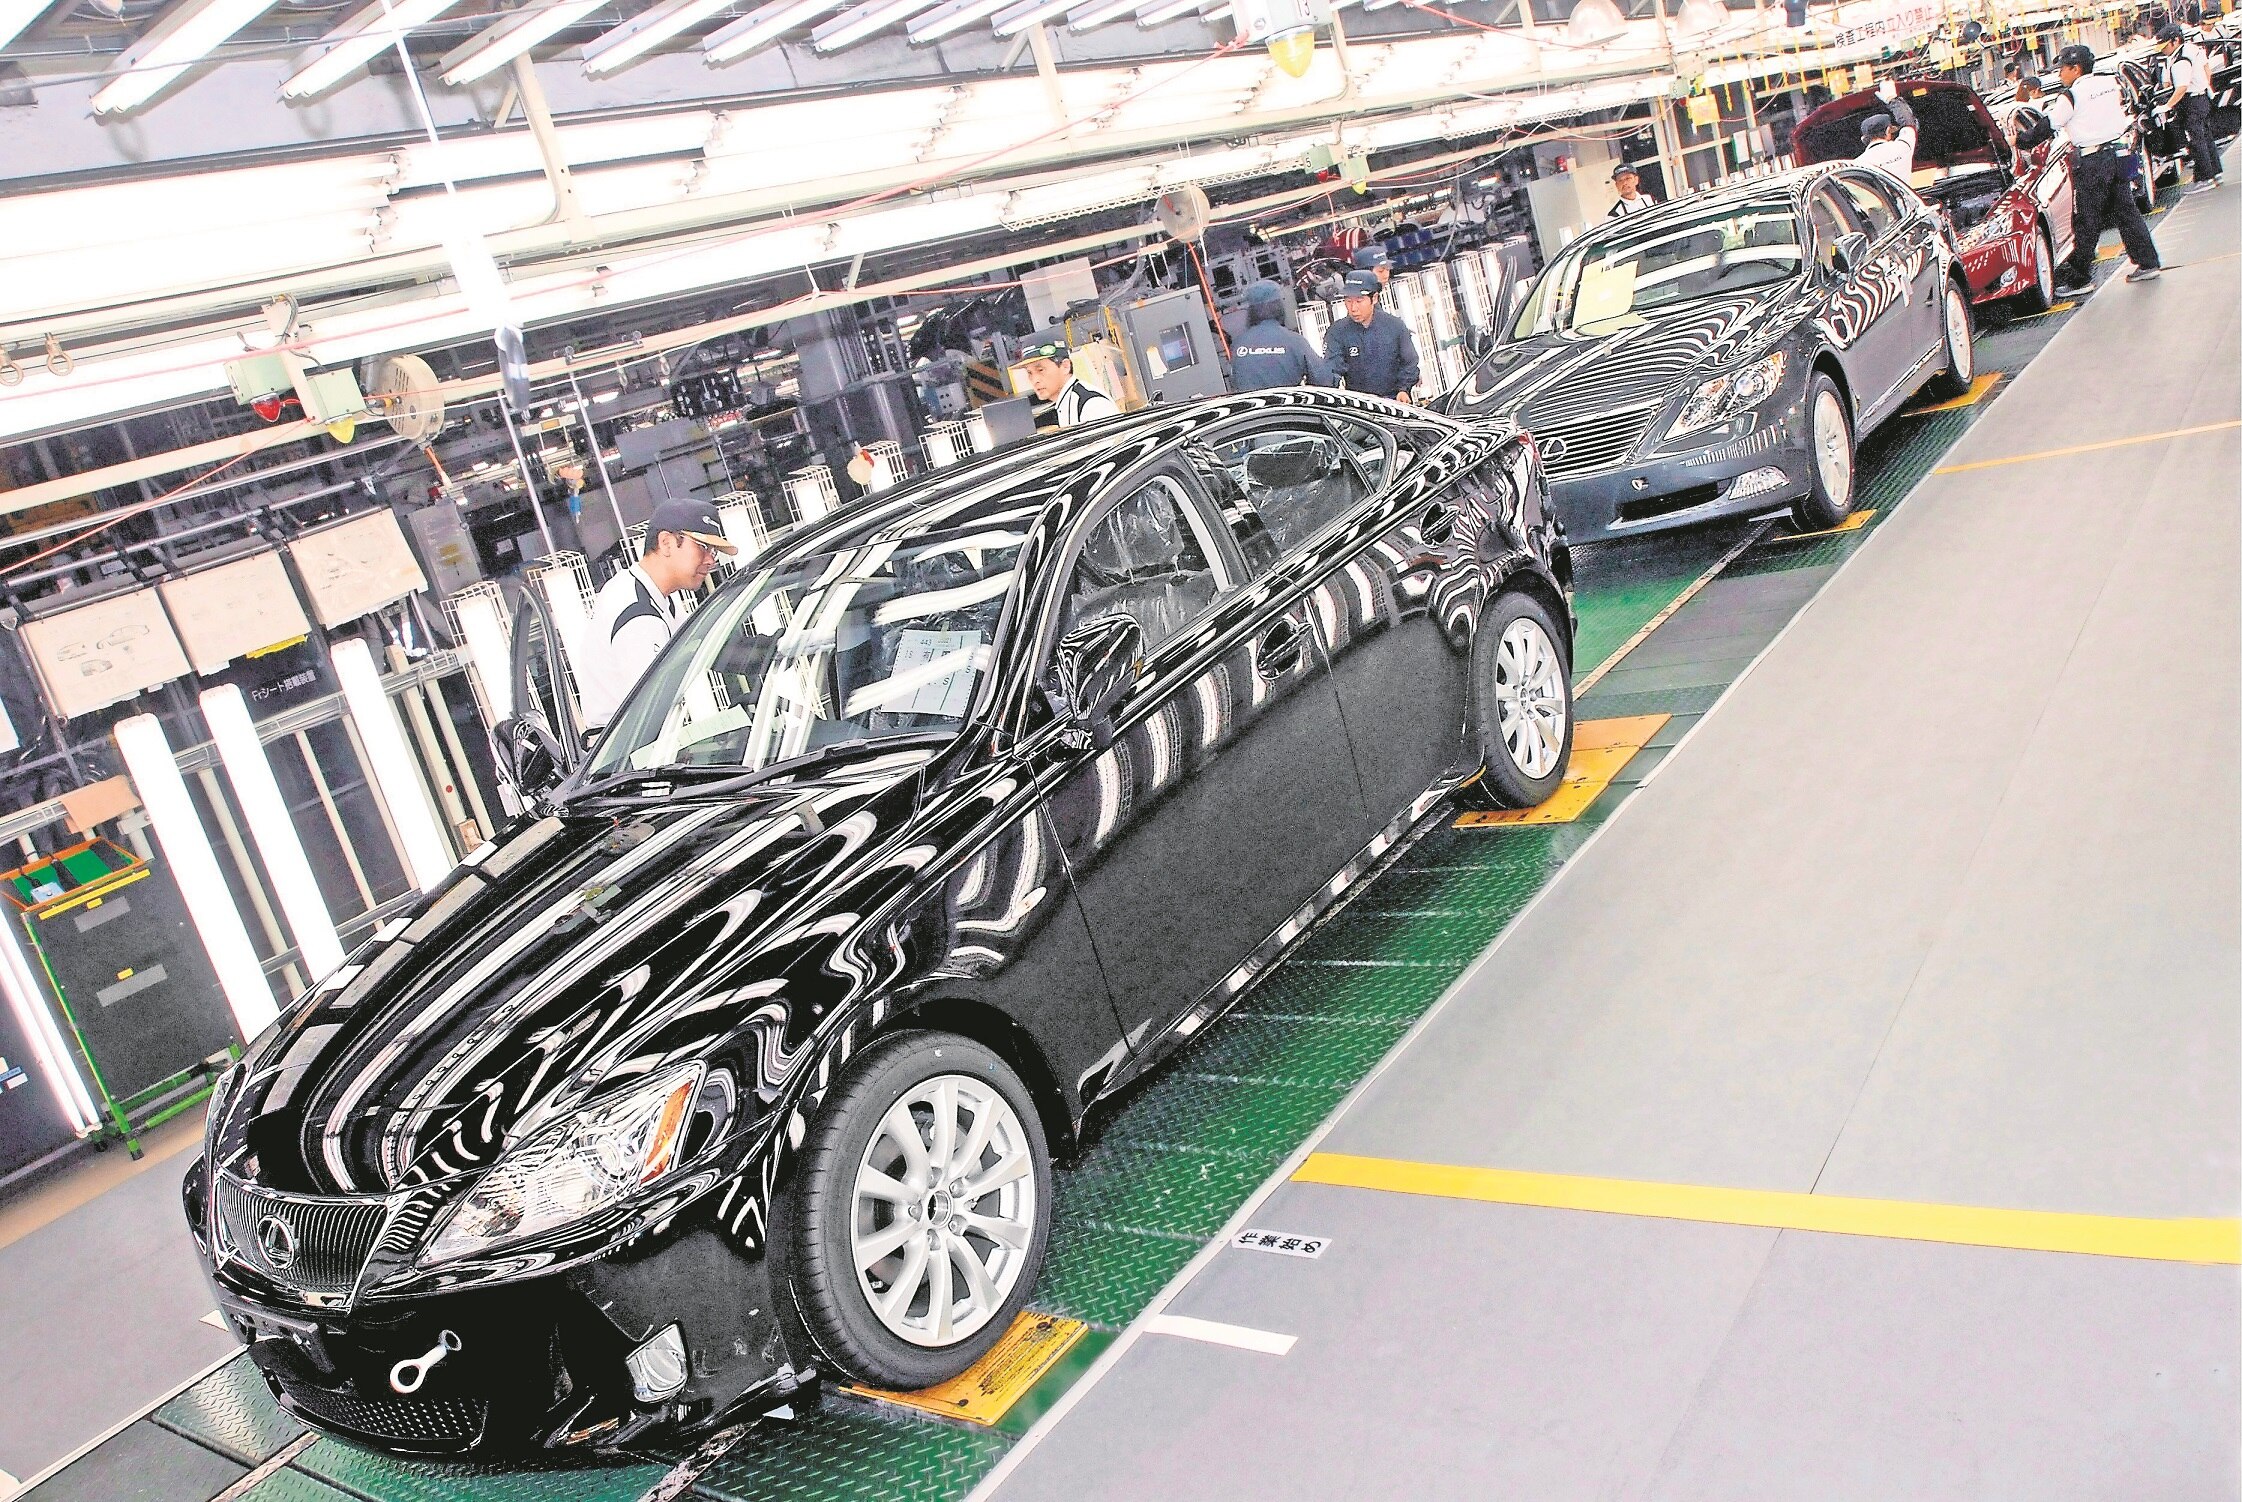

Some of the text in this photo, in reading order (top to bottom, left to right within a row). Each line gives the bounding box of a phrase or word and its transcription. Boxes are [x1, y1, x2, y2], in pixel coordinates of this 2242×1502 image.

[1306, 157, 1312, 168] 5
[1249, 347, 1286, 355] LEXUS
[942, 677, 950, 686] S
[1238, 1232, 1322, 1254] 作業始め
